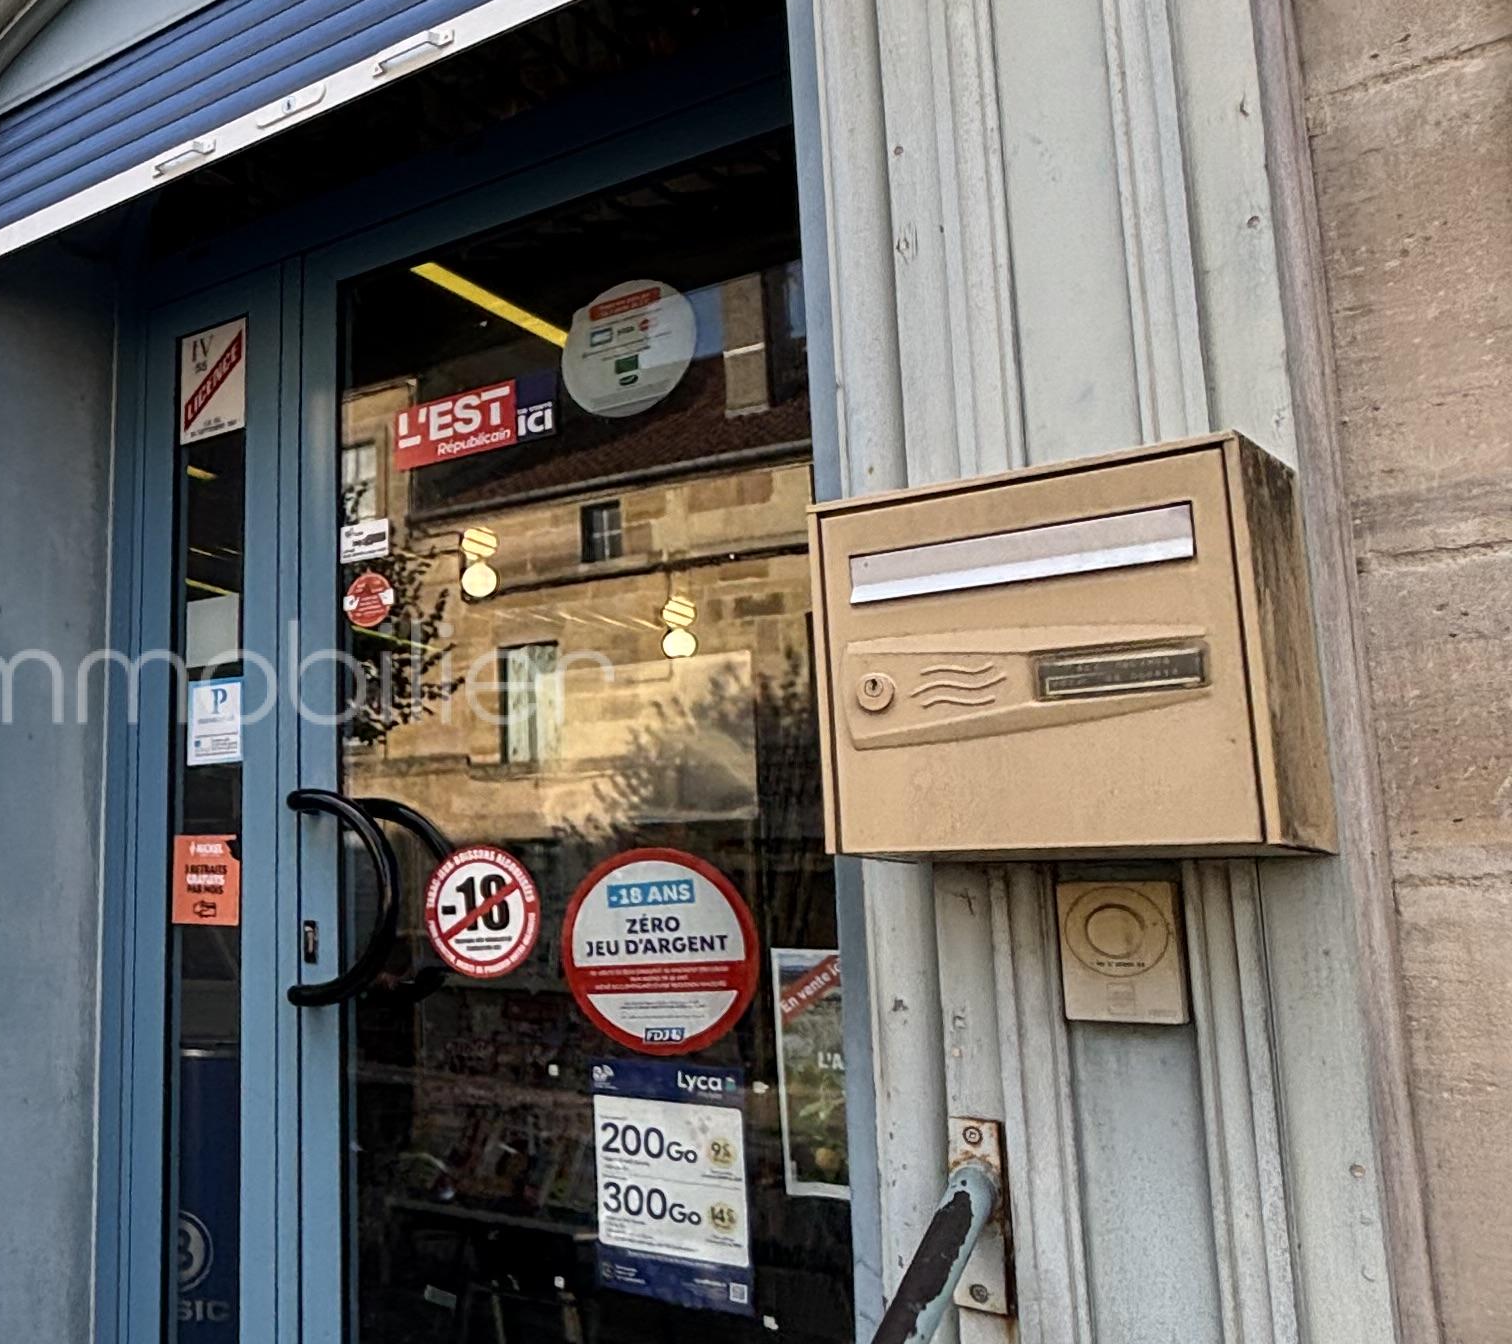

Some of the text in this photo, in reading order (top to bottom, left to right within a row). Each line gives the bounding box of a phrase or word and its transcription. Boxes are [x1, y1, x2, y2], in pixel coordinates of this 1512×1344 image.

[192, 334, 214, 362] IV
[187, 339, 241, 422] LICENCE
[398, 385, 511, 450] L'EST
[437, 427, 512, 456] Républicain
[441, 874, 510, 931] -18
[610, 884, 691, 905] -18 ANS
[625, 913, 681, 935] ZÉRO
[586, 934, 729, 958] JEU D'ARGENT
[780, 996, 800, 1013] En
[797, 971, 831, 1001] vente
[646, 1028, 670, 1042] FDJ
[677, 1070, 723, 1092] Lyca
